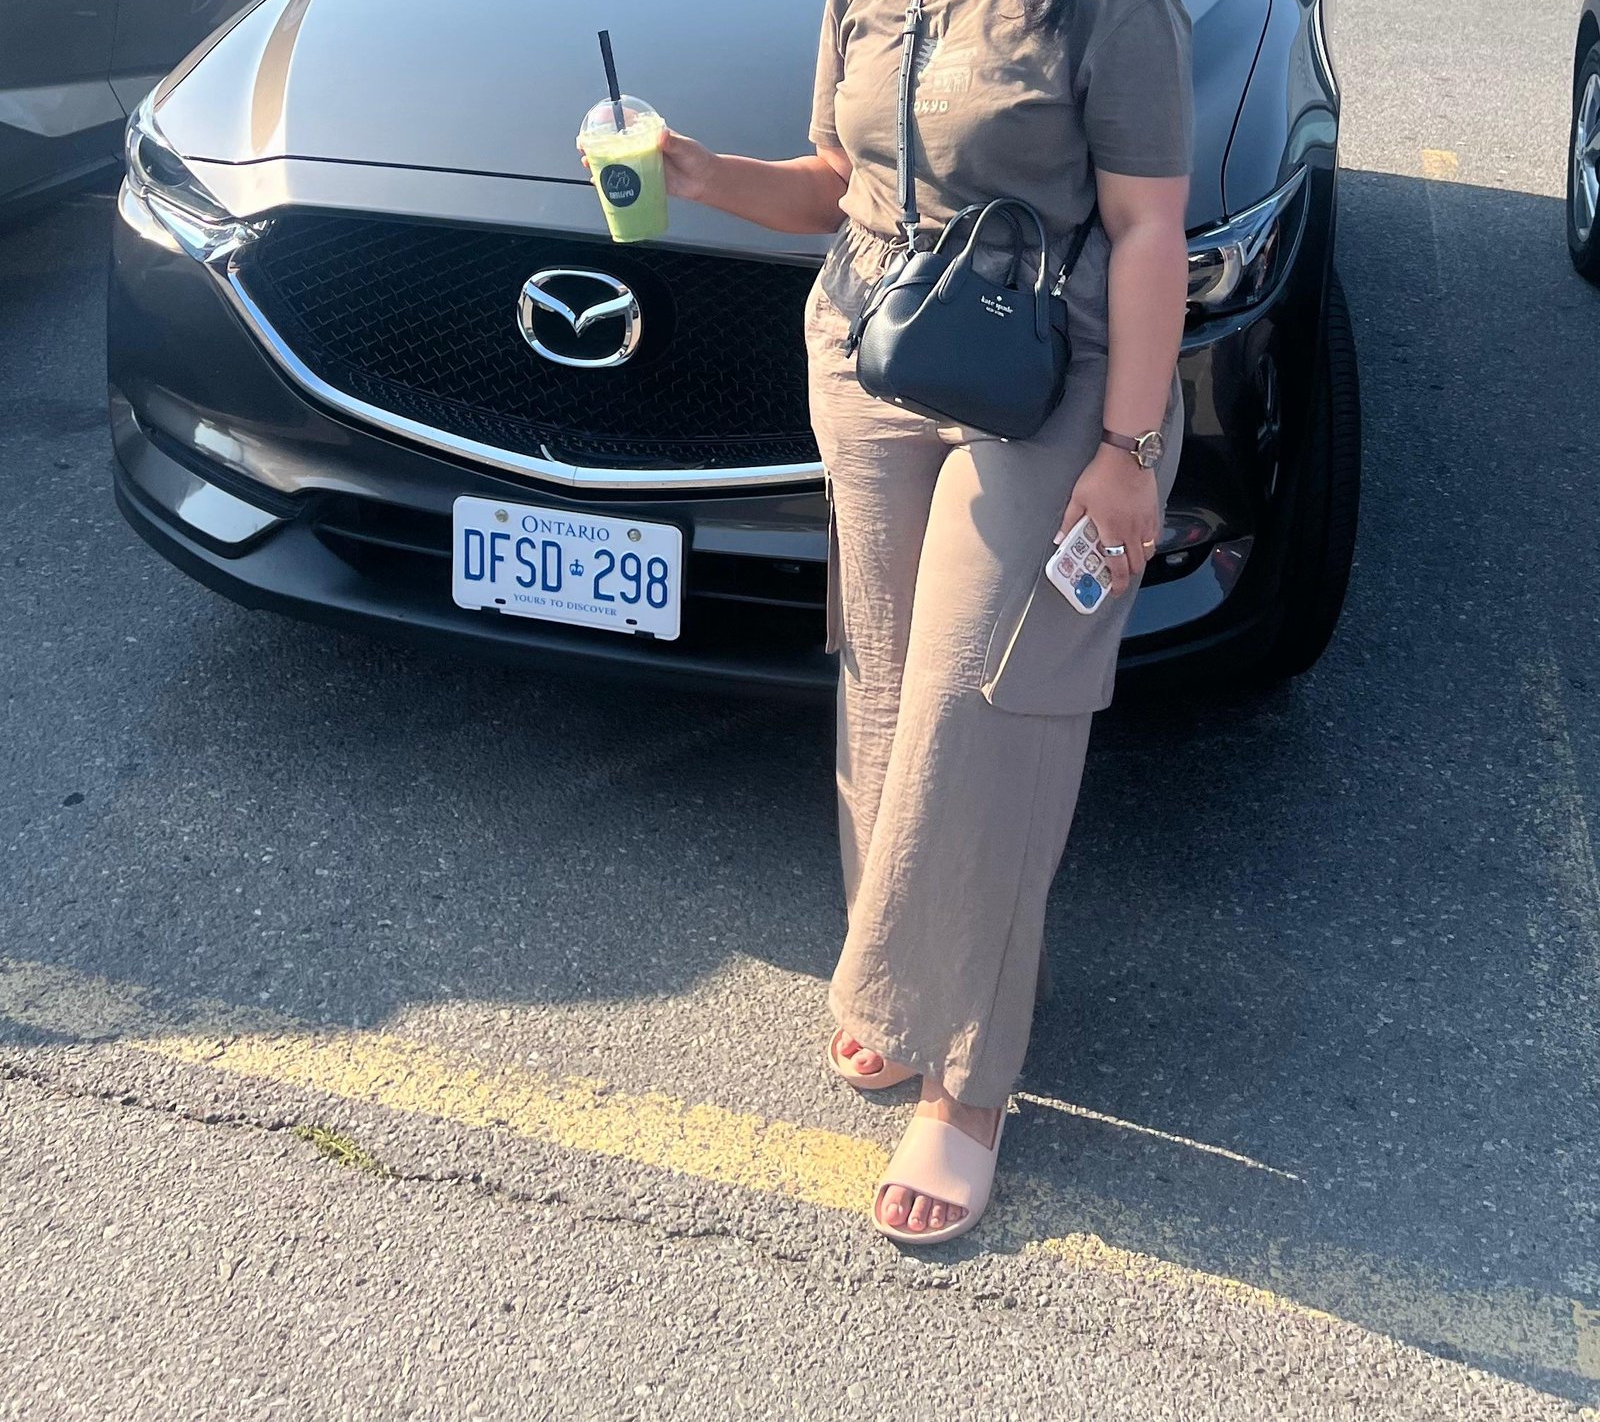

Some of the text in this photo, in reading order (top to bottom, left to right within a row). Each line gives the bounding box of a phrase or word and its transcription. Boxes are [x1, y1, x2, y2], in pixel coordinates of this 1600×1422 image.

[521, 515, 610, 543] ONTARIO
[464, 529, 668, 609] DFSD 298
[513, 593, 618, 616] YOURS TO DISCOVER
